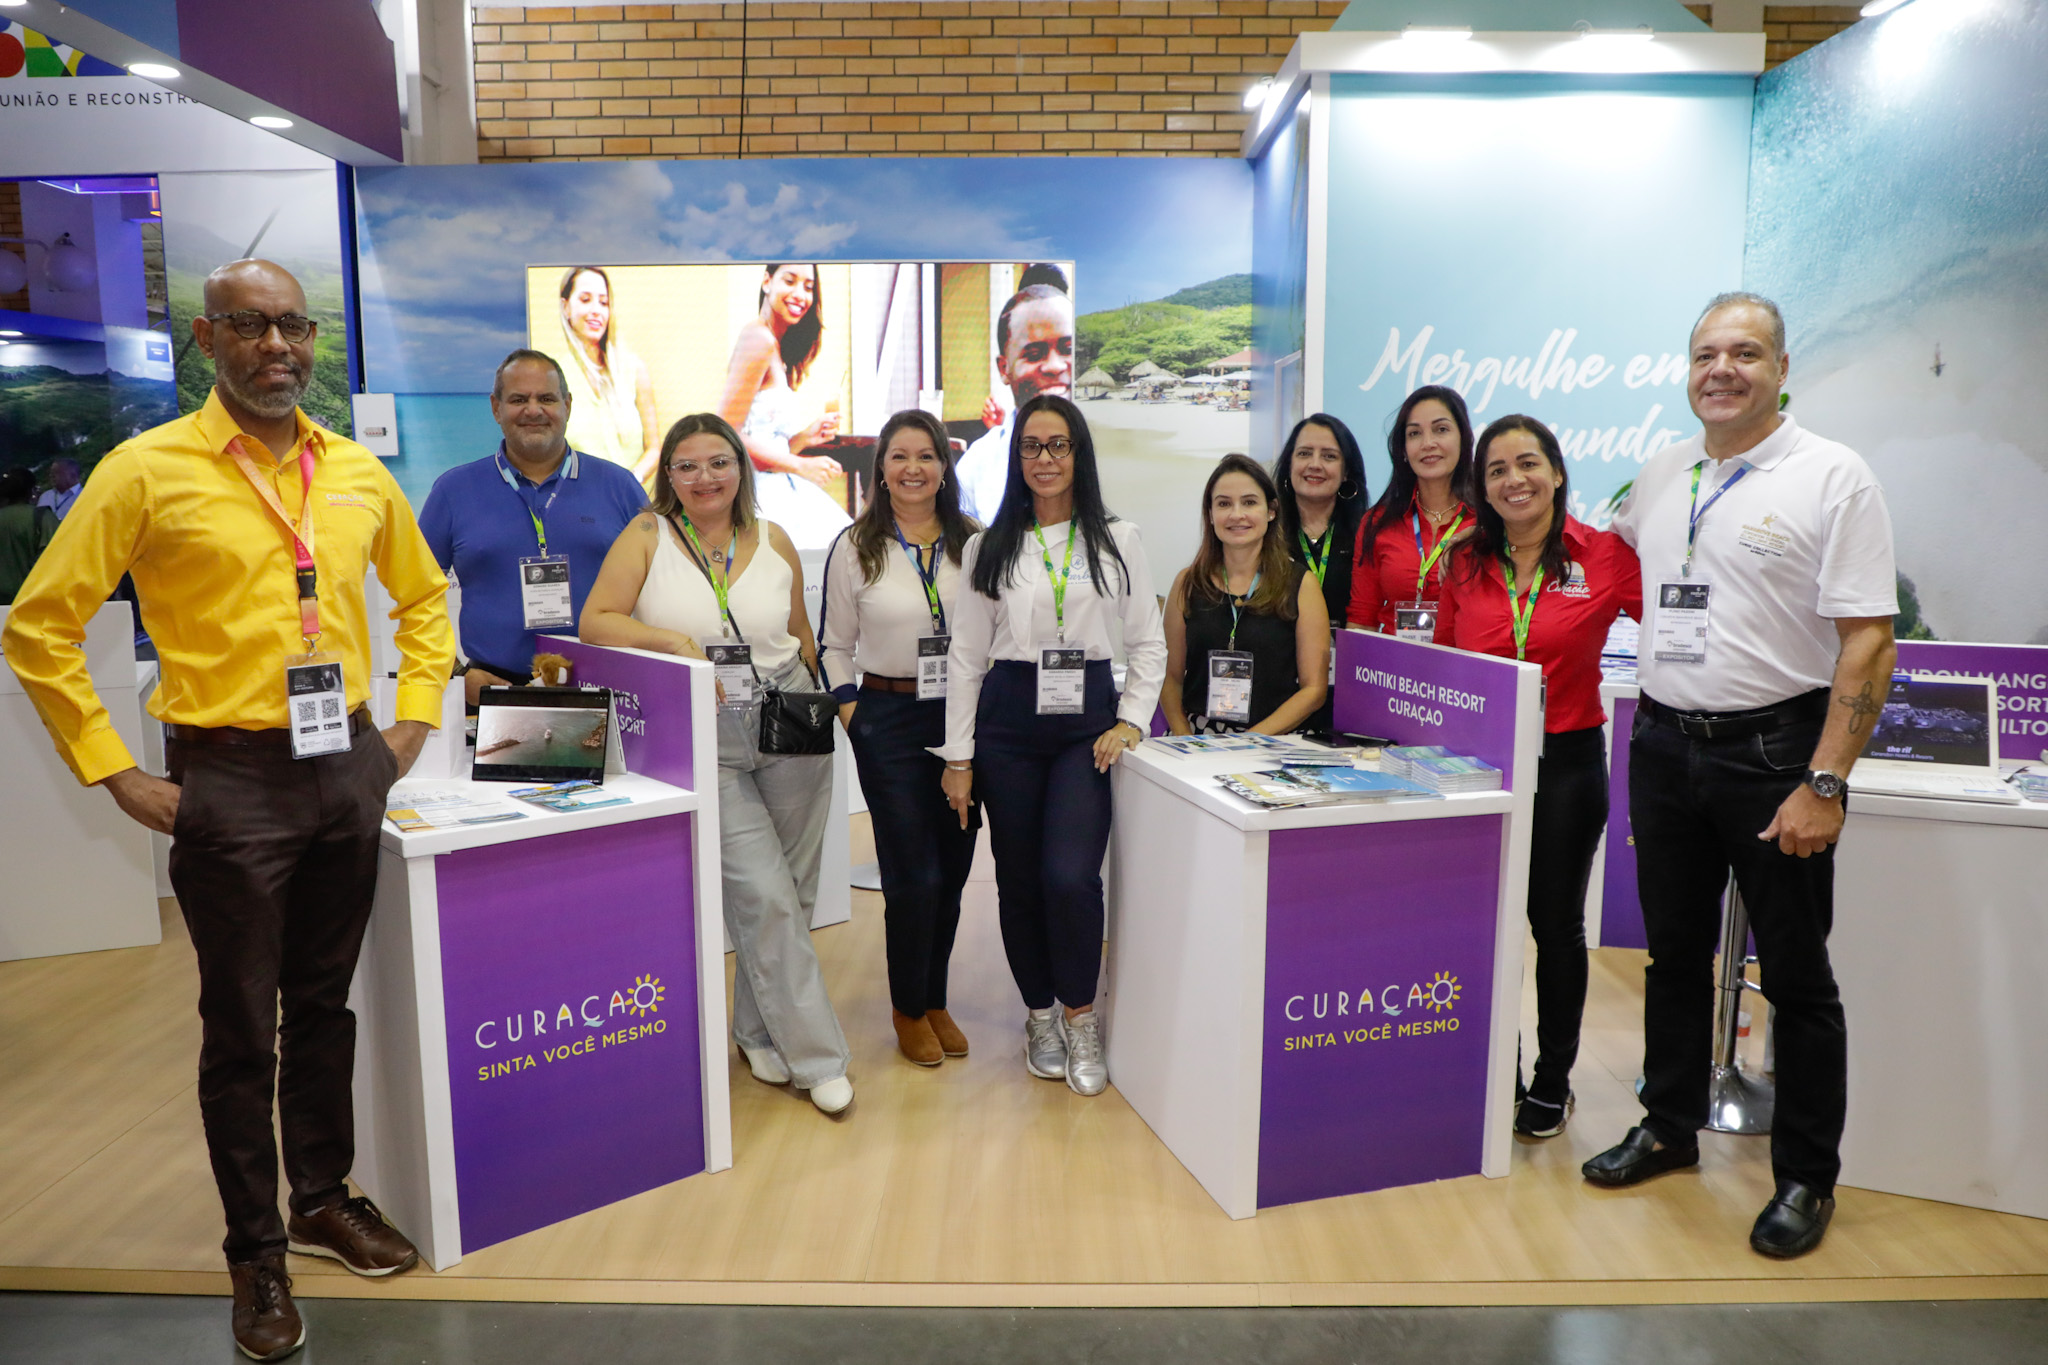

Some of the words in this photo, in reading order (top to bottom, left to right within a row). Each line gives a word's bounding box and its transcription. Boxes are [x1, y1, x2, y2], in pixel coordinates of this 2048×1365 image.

[0, 91, 59, 107] UNIÃO
[69, 93, 77, 106] E
[1359, 325, 1615, 413] Mergulhe
[1550, 403, 1682, 464] undo
[615, 689, 631, 708] IVE
[1355, 665, 1396, 690] KONTIKI
[1399, 676, 1436, 701] BEACH
[1438, 686, 1486, 714] RESORT
[1997, 695, 2048, 713] SORT
[618, 714, 646, 736] SORT
[1388, 697, 1443, 726] CURAÇAO
[2001, 718, 2048, 736] ILTO
[475, 978, 661, 1048] CURAÇAO
[1285, 976, 1457, 1021] CURAÇAO
[478, 1054, 536, 1081] SINTA
[543, 1035, 596, 1063] VOCÊ
[602, 1019, 667, 1048] MESMO
[1284, 1033, 1336, 1051] SINTA
[1343, 1023, 1392, 1044] VOCÊ
[1398, 1017, 1460, 1037] MESMO
